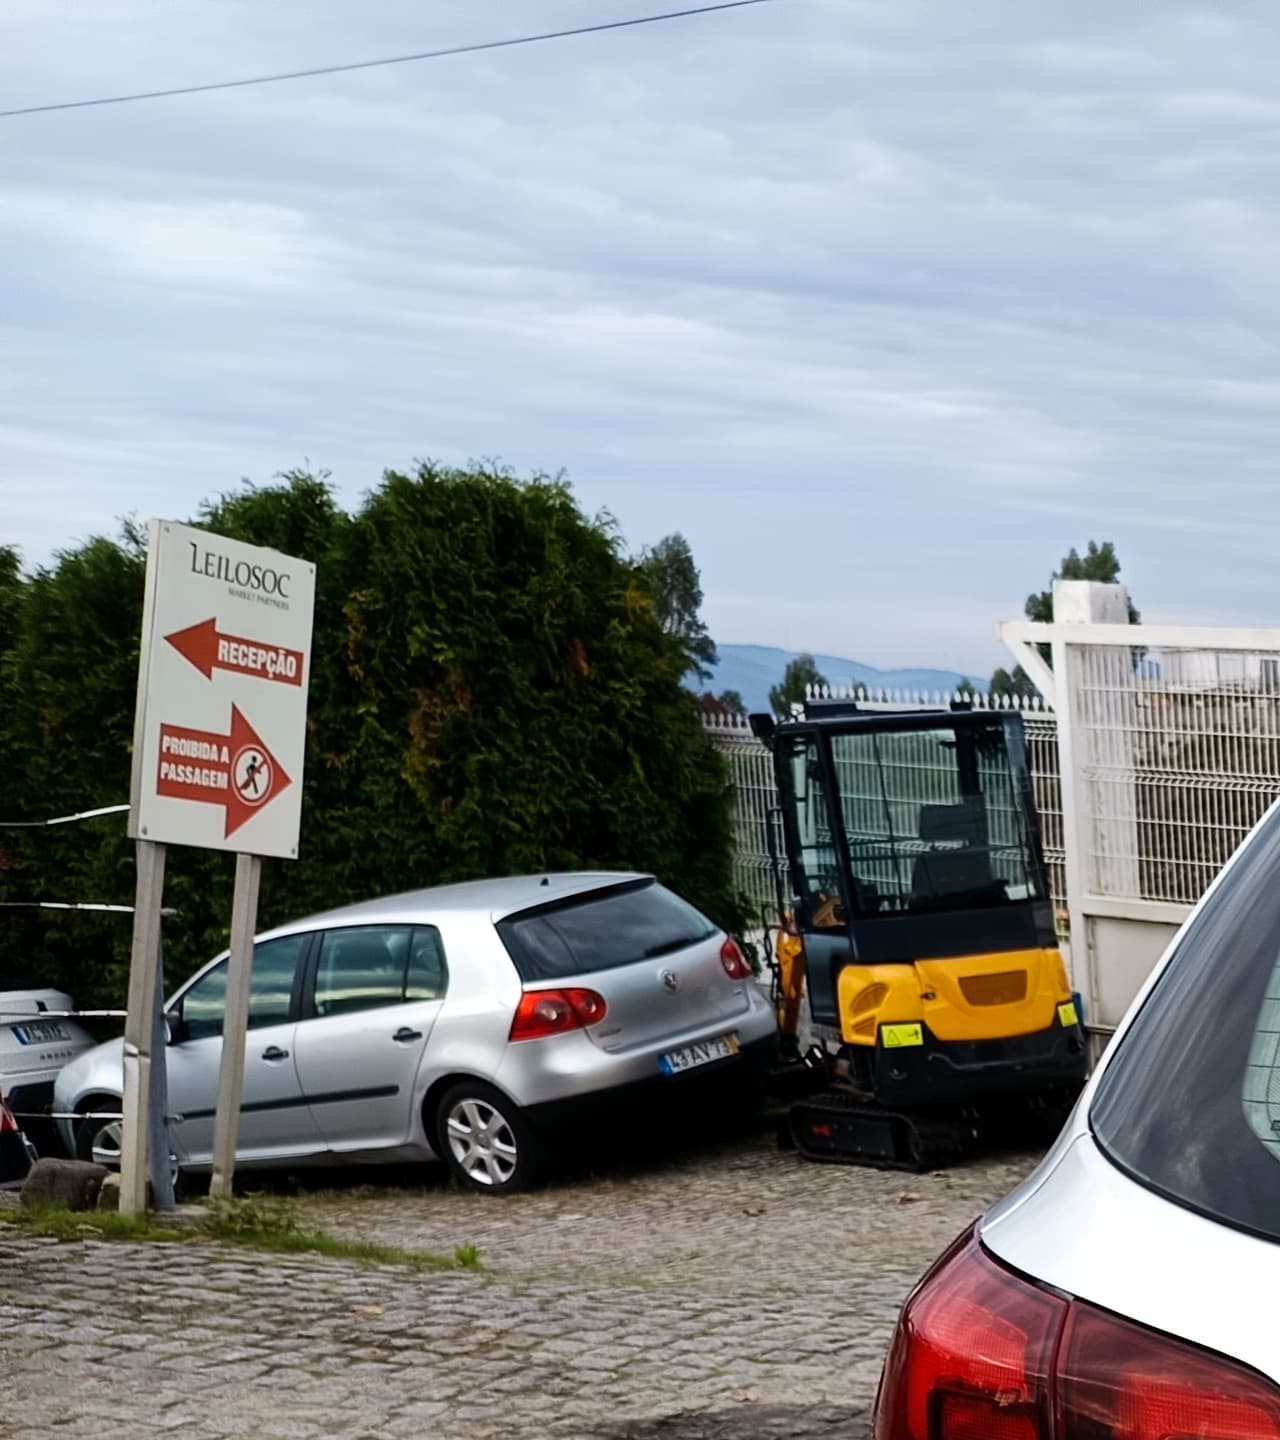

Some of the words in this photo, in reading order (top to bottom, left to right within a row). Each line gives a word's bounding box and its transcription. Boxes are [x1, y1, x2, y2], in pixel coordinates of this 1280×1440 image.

[189, 541, 291, 599] LEILOSOC
[217, 639, 297, 680] RECEPÇÃO
[161, 734, 218, 763] PROIBIDA
[220, 745, 230, 764] A
[160, 760, 229, 790] PASSAGEM
